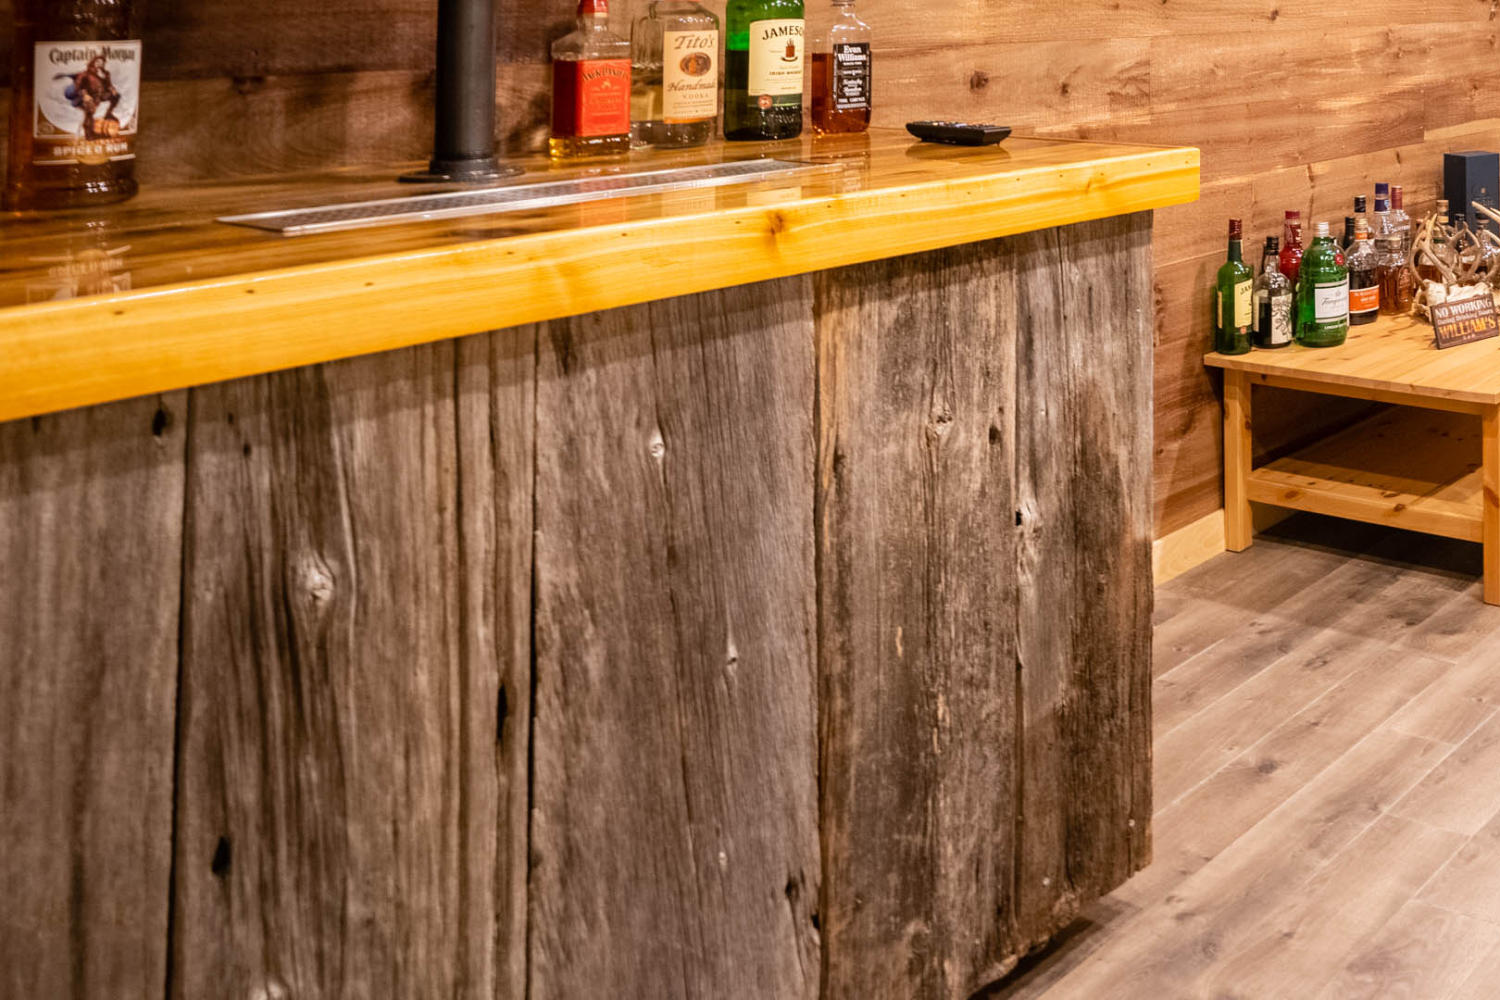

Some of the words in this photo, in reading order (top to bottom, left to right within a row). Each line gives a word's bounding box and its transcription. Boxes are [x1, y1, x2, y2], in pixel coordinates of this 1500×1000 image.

[674, 34, 714, 50] Tito's
[843, 45, 862, 54] Evan
[48, 48, 97, 65] Captain
[838, 53, 866, 62] Williams
[1435, 306, 1448, 318] NO
[1449, 298, 1492, 315] WORKING
